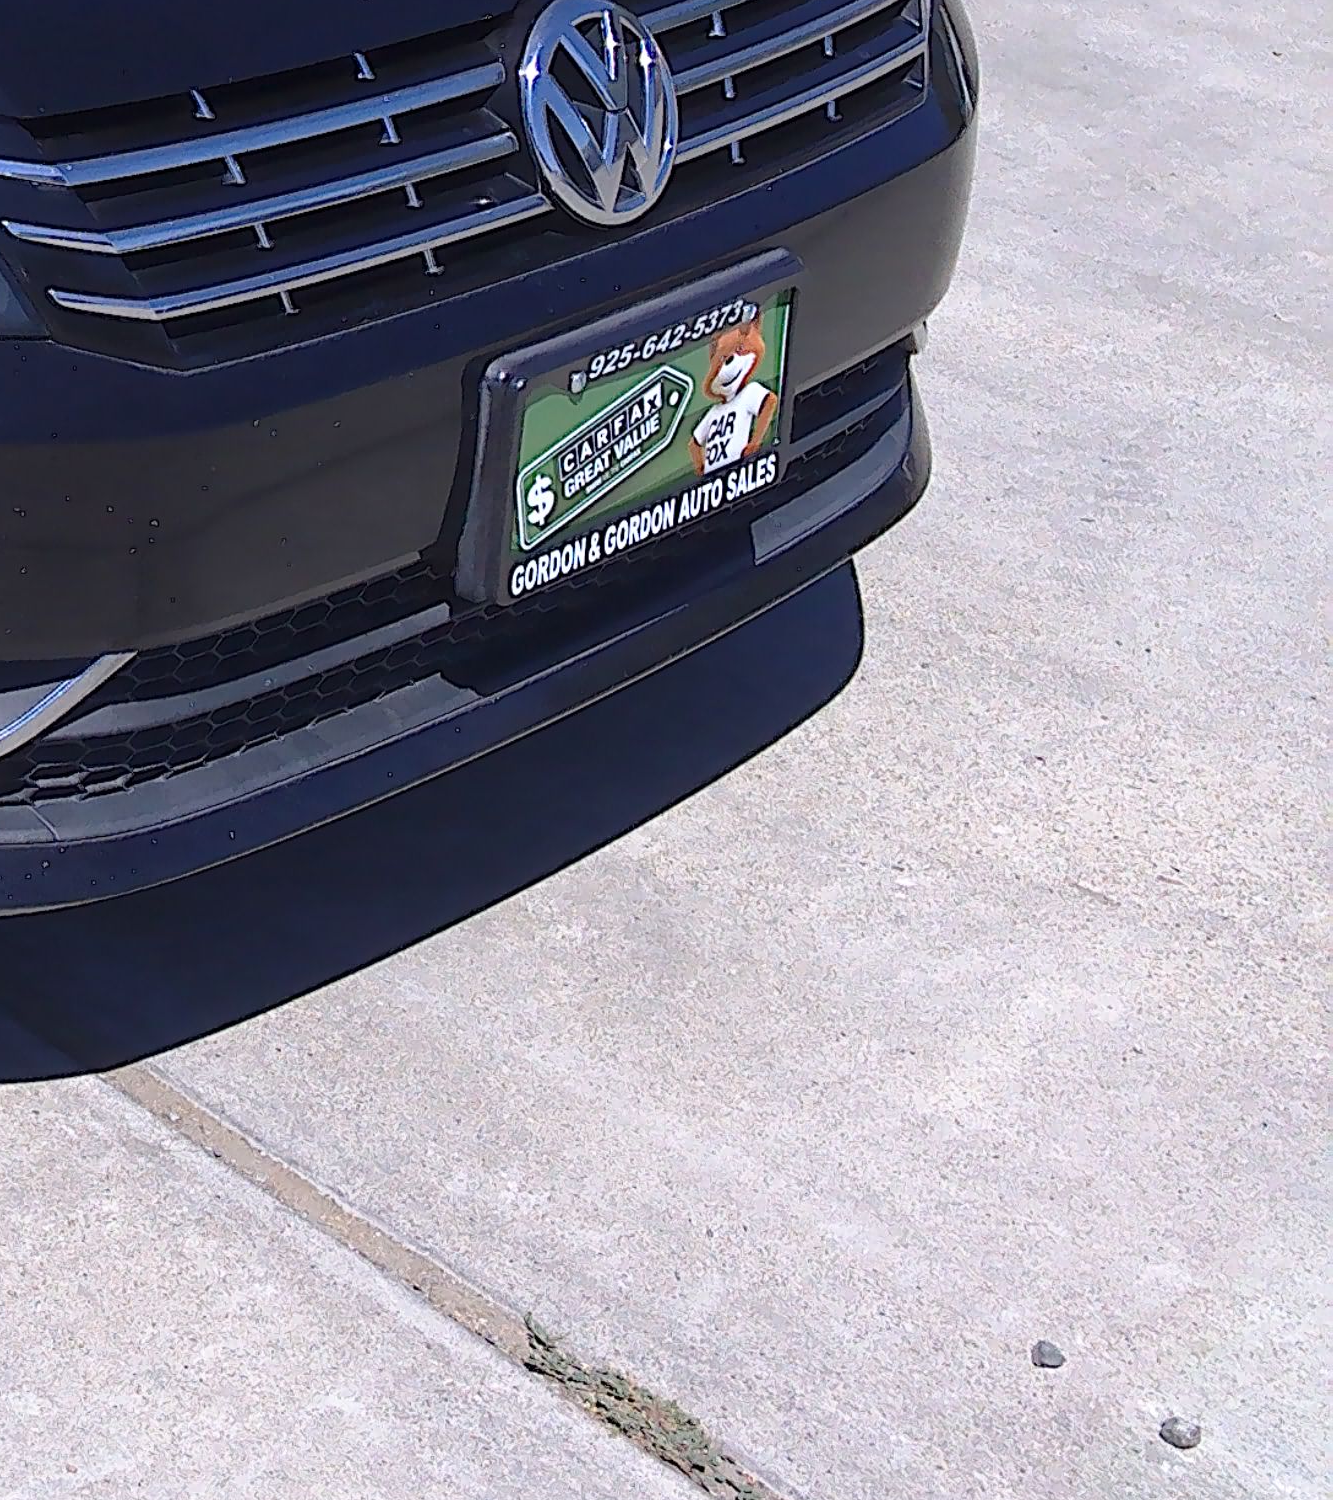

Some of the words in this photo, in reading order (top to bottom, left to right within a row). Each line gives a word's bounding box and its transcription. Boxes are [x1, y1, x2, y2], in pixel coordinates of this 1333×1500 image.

[589, 299, 744, 379] 925-642-5373
[562, 382, 663, 474] CARFAX
[564, 449, 612, 498] GREAT
[613, 412, 661, 460] VALUE
[707, 411, 737, 443] CAR
[511, 537, 587, 596] GORDON
[588, 531, 601, 563] &
[604, 498, 676, 555] GORDON
[678, 478, 723, 524] AUTO
[726, 454, 777, 501] SALES
